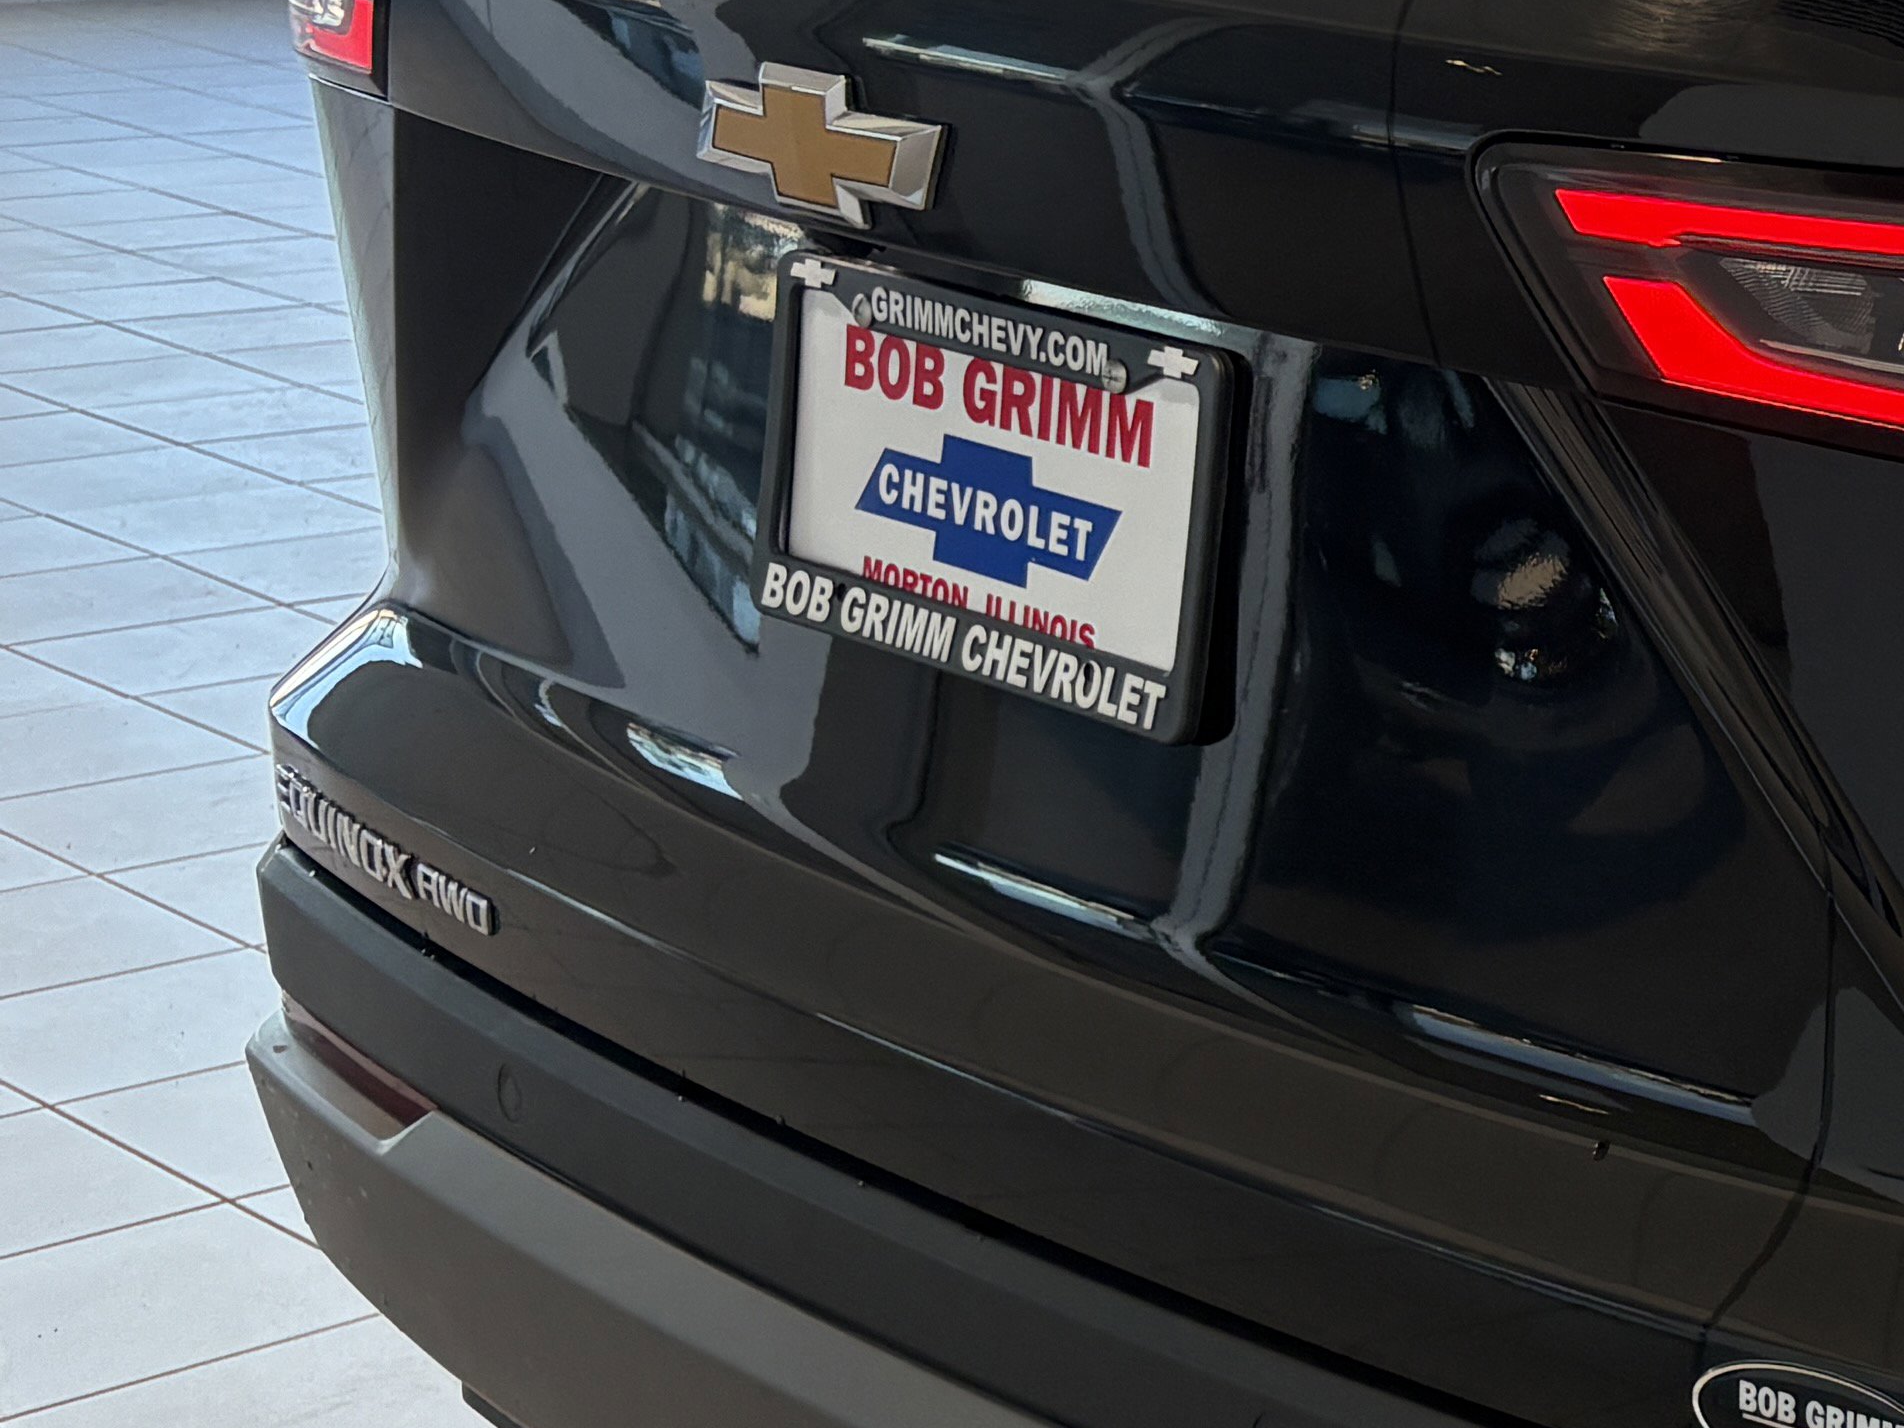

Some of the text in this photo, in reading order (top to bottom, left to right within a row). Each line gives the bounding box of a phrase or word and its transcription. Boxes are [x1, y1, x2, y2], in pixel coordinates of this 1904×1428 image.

[871, 286, 1107, 376] GRIMMCHEVY.COM
[844, 324, 1155, 469] BOB GRIMM
[878, 463, 1093, 561] CHEVROLET
[761, 562, 1167, 730] BOB GRIMM CHEVROLET
[416, 863, 494, 936] AWD
[1738, 1379, 1796, 1425] BOB
